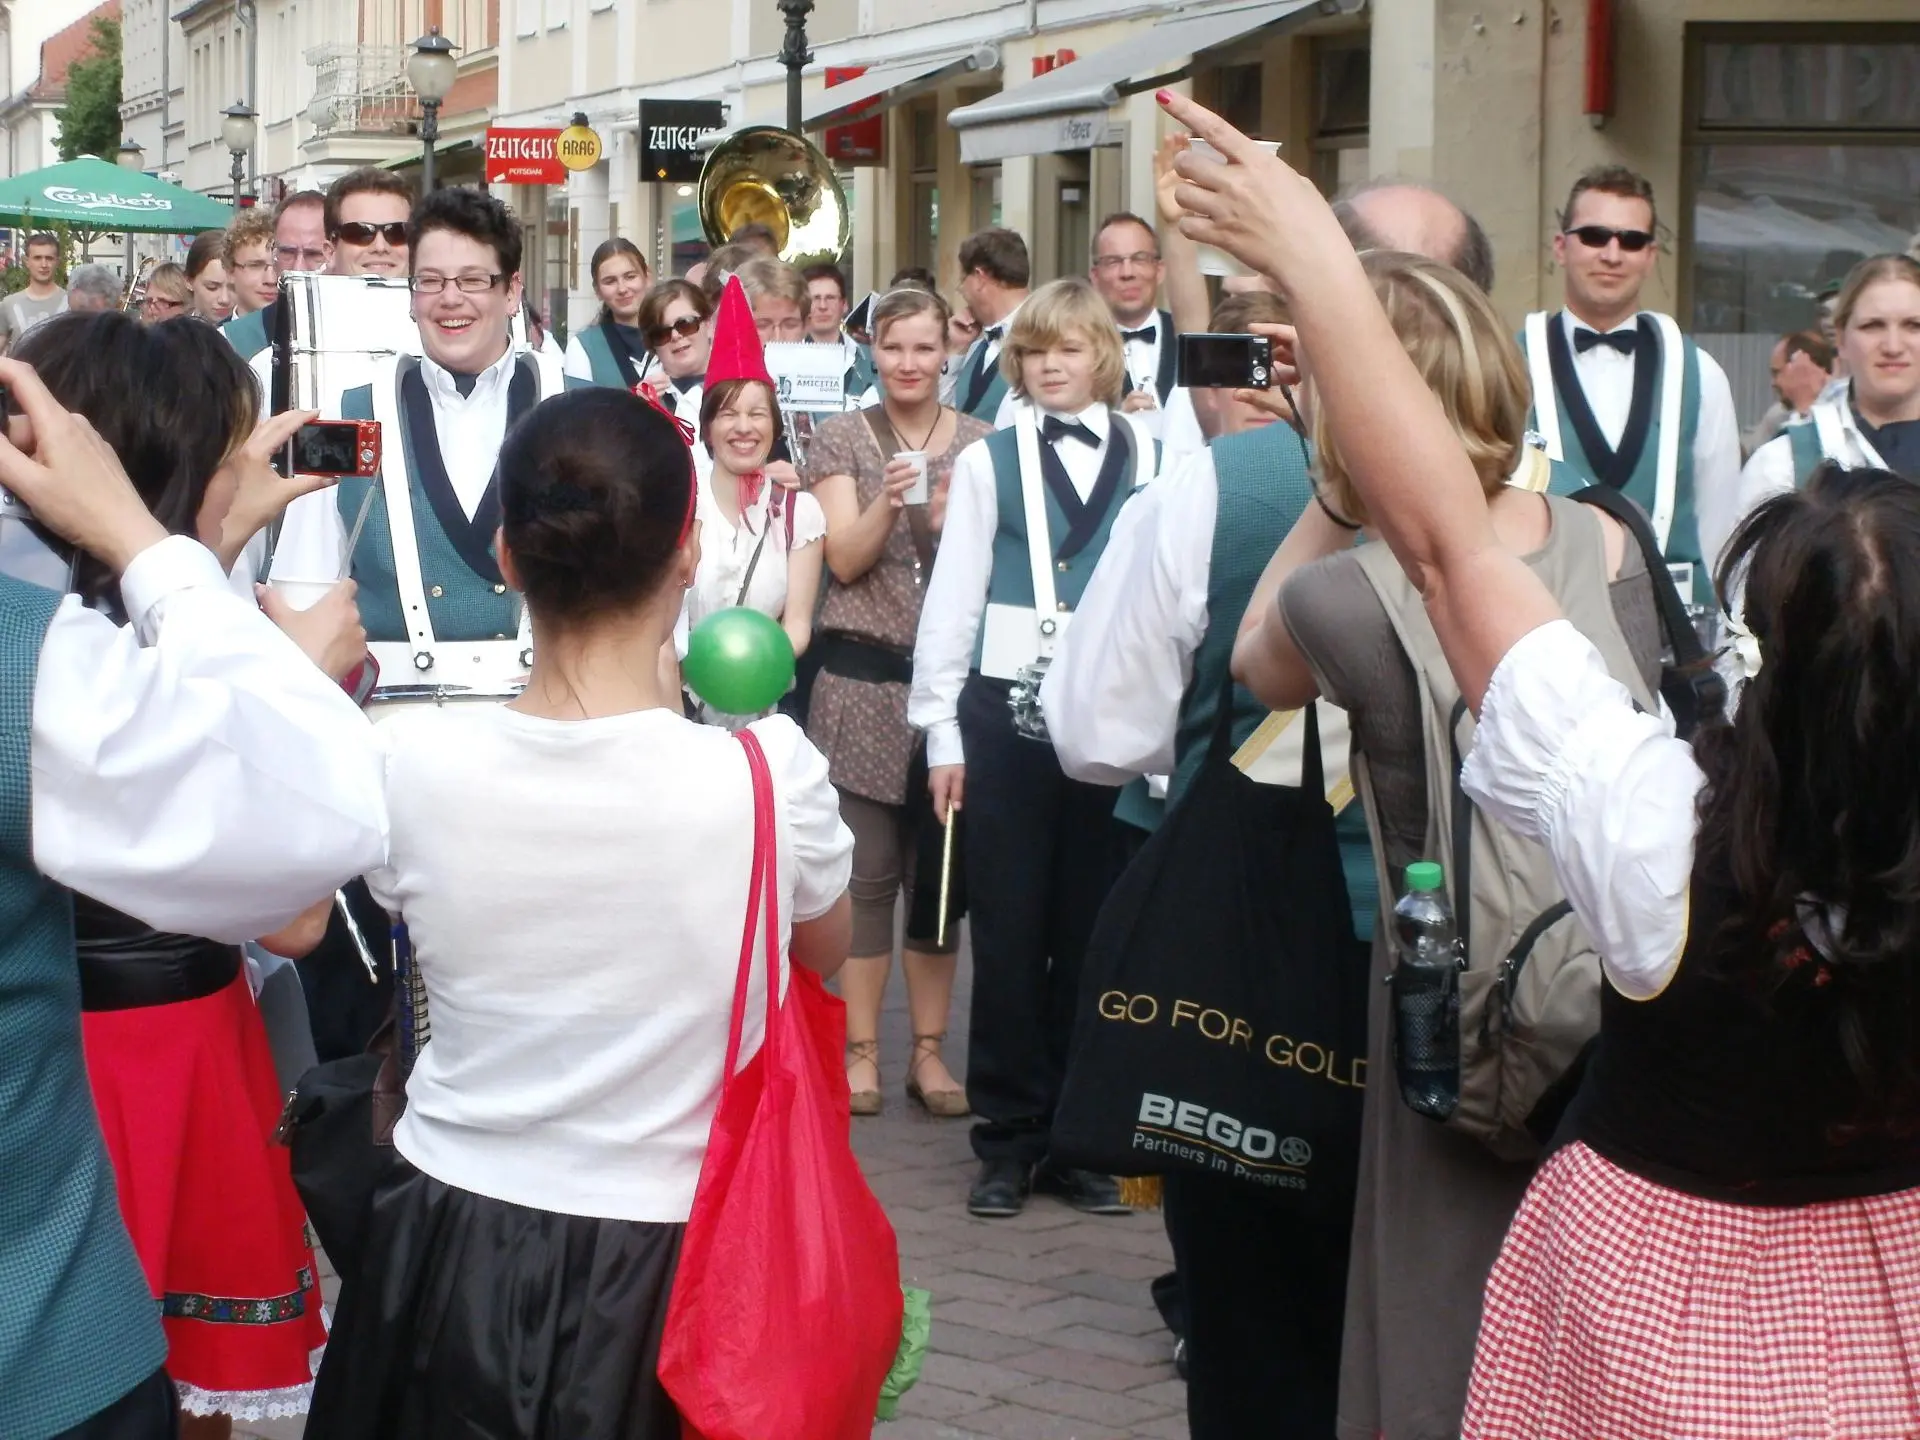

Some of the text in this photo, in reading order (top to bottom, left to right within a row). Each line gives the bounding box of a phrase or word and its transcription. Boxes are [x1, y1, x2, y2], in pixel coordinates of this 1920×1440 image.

[489, 137, 558, 159] ZEITGEIS
[563, 140, 595, 155] ARAG
[43, 186, 172, 211] Carlsberg
[797, 379, 840, 387] AMICITIA
[1098, 990, 1367, 1088] GO FOR GOLD
[1138, 1092, 1277, 1159] BEGO
[1132, 1132, 1307, 1191] Partners in Progress
